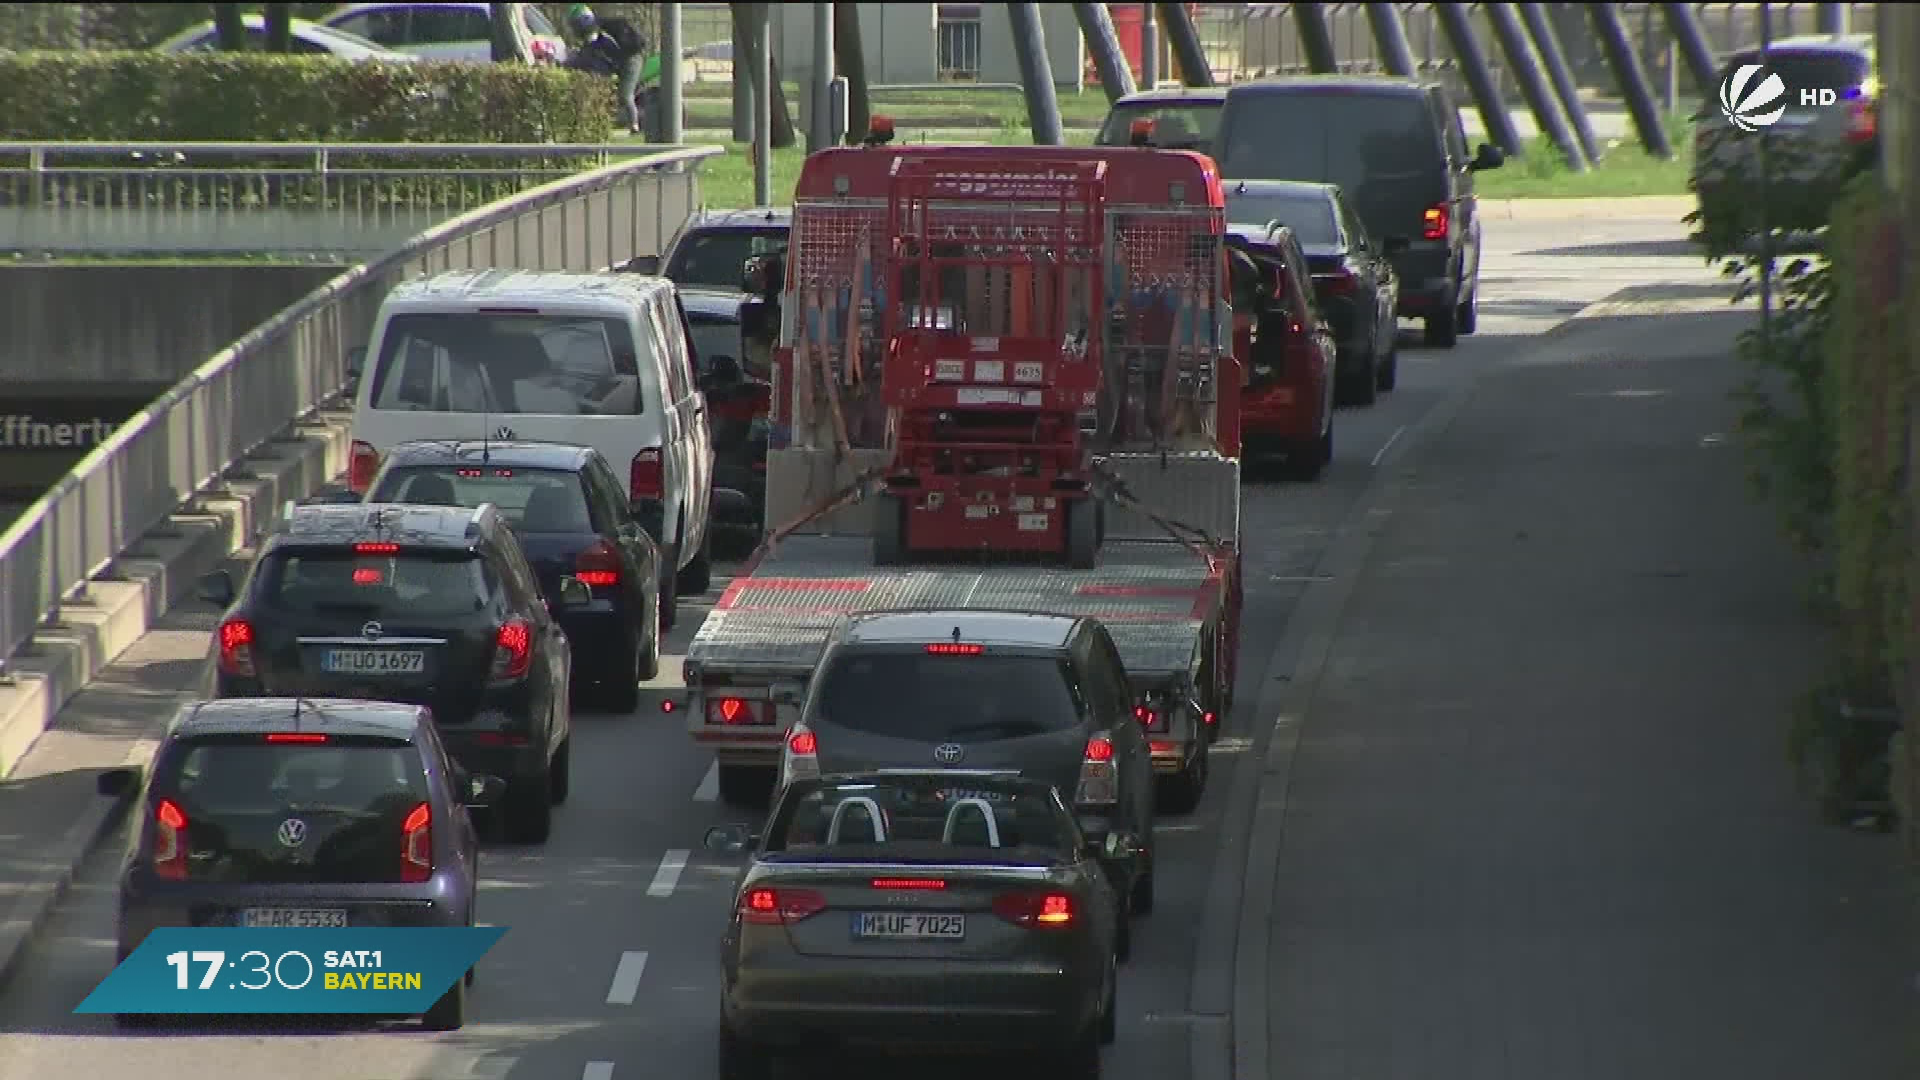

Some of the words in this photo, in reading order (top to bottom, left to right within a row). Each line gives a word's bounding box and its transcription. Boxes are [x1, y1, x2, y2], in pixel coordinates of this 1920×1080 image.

[379, 652, 421, 670] 1697
[298, 910, 345, 927] 5533
[863, 916, 876, 934] M
[889, 916, 913, 934] UF
[916, 916, 962, 934] 7025
